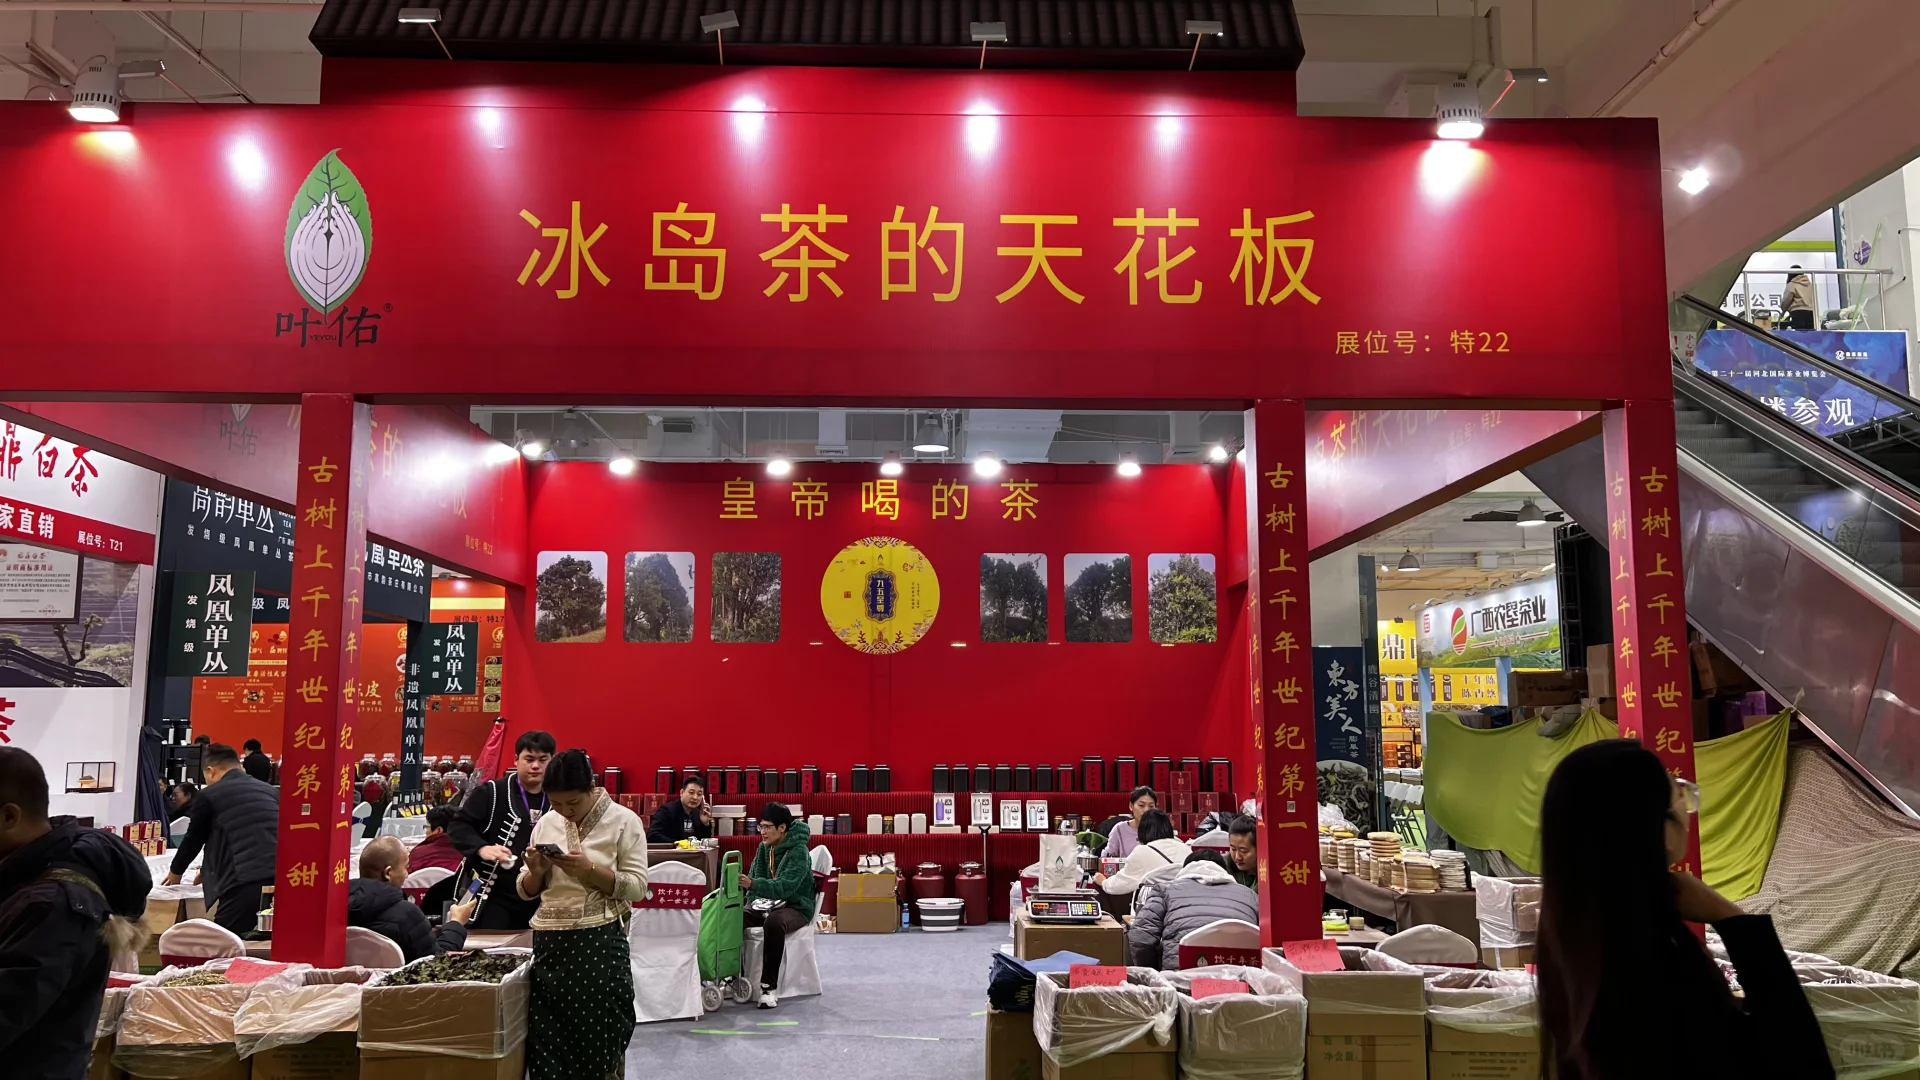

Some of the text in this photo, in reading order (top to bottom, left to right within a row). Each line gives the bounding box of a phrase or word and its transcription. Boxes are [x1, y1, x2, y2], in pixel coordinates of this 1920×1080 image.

[516, 201, 1322, 306] 冰岛茶的天花板
[275, 306, 382, 348] 叶佑
[1335, 330, 1510, 354] 展位号：特22
[1711, 369, 1827, 378] 第二十一届河北国际茶业博览会
[719, 477, 1040, 521] 皇帝喝的茶
[77, 530, 123, 552] 展位号：T21
[365, 543, 425, 577] 凰单丛茶
[184, 595, 198, 653] 发烧级
[201, 574, 234, 675] 凤凰单丛
[1470, 595, 1547, 637] 广西农垦茶业
[1640, 466, 1687, 777] 古树上千年世纪
[286, 456, 339, 887] 古树上千年世纪第一甜
[334, 469, 364, 884] 古树上千年世纪第一甜
[432, 639, 441, 679] 发烧级
[444, 624, 466, 693] 凤凰单丛
[1264, 462, 1311, 886] 古树上千年世纪第一甜
[404, 663, 421, 764] 非遗凤凰单丛
